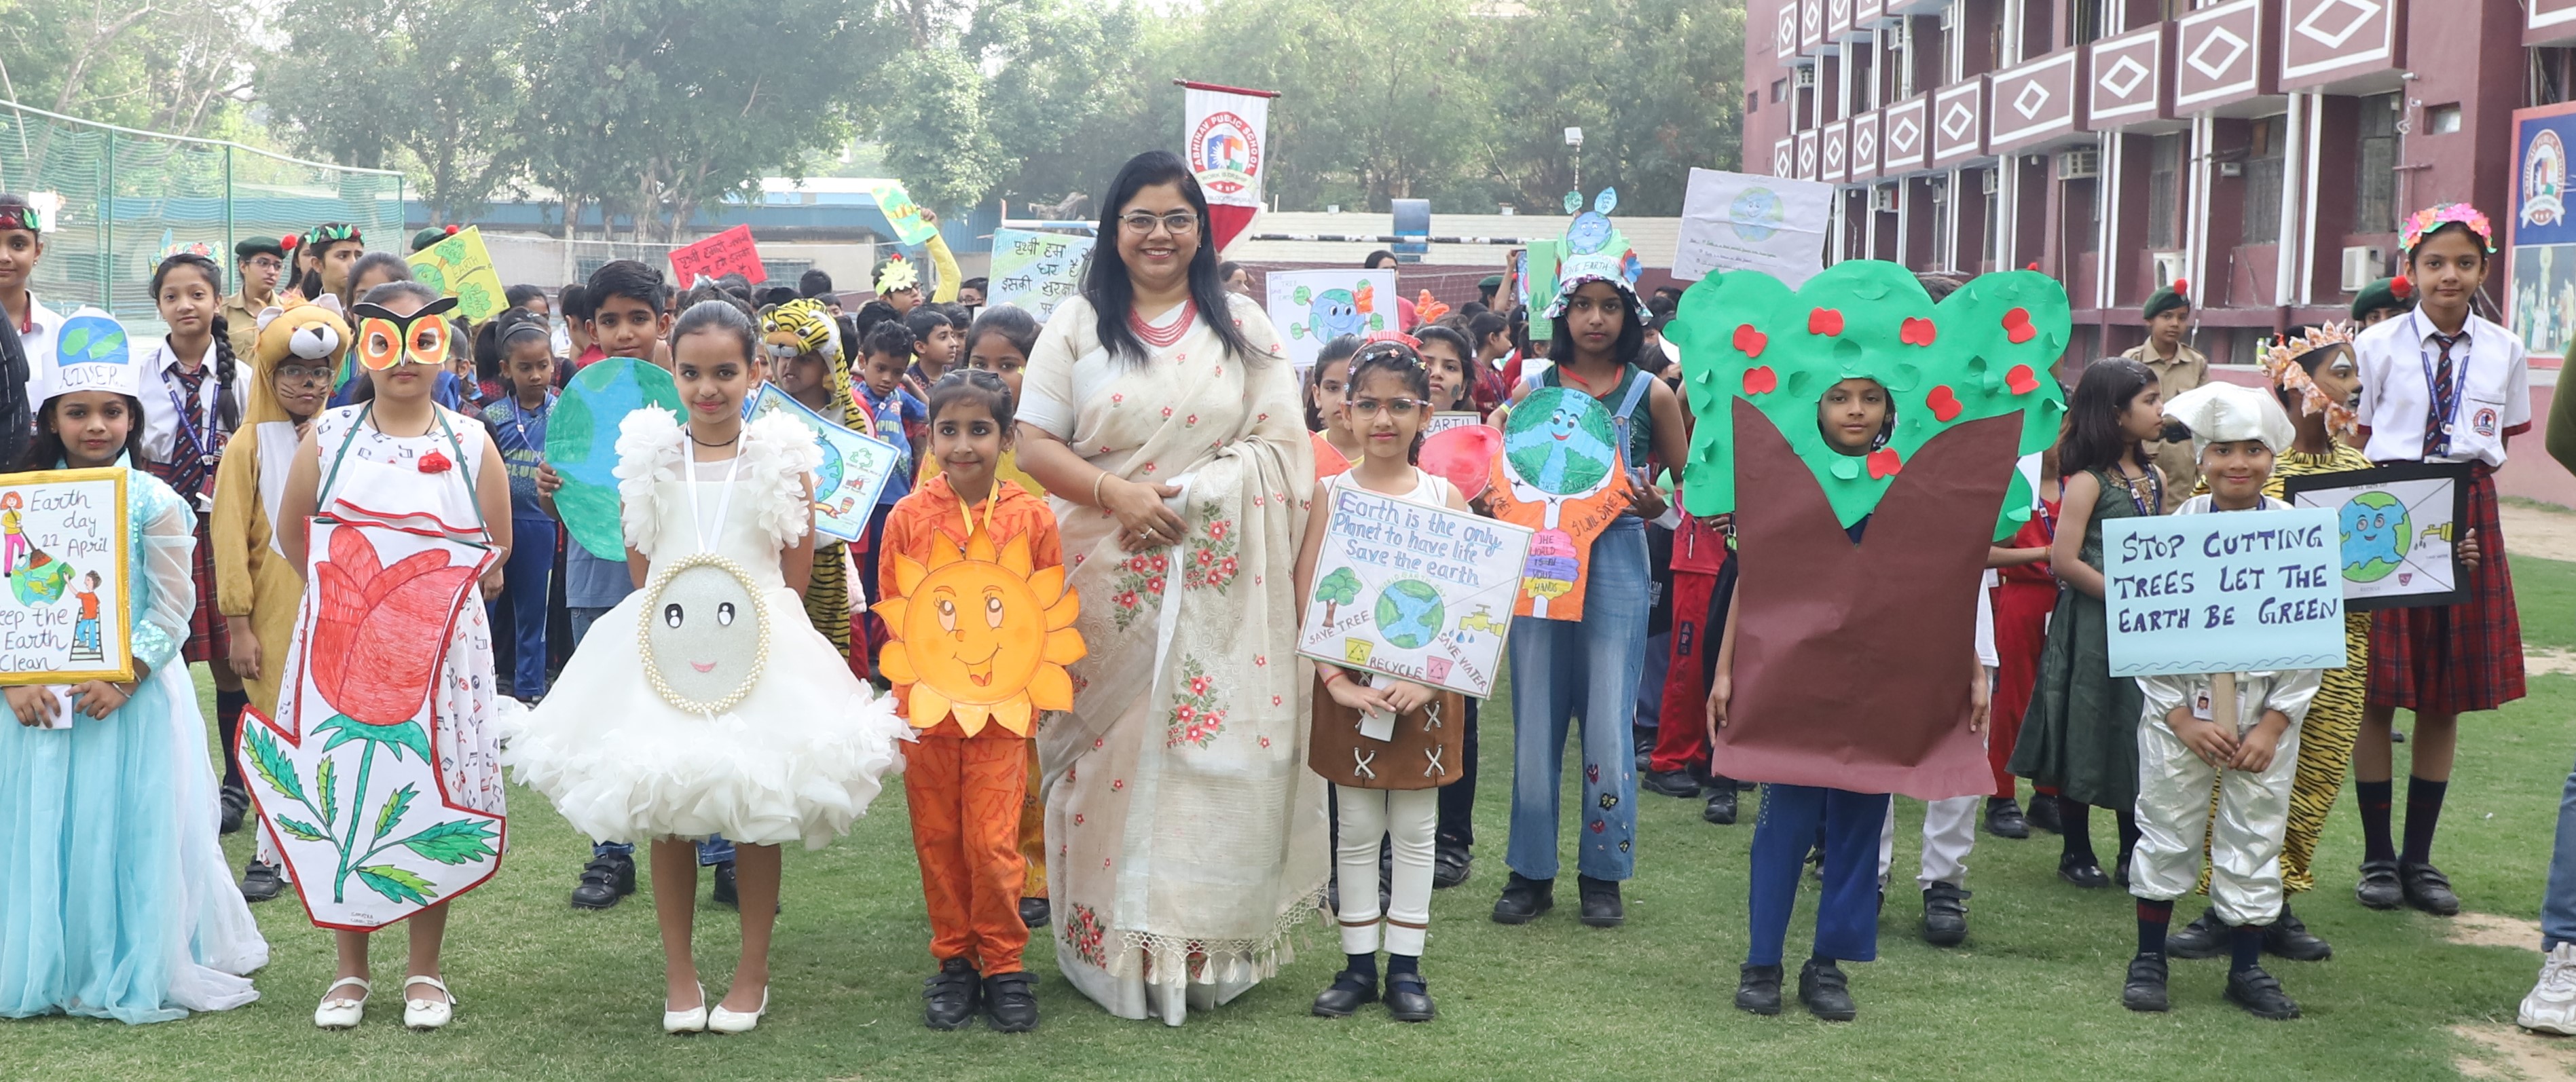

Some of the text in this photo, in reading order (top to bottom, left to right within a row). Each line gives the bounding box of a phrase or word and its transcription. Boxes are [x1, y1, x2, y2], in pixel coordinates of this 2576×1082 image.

[1192, 113, 1258, 170] ABHINAV PUBLIC SCHOOL
[1014, 237, 1039, 255] पृथ्वी
[451, 255, 480, 280] EARTH
[1583, 261, 1609, 272] EARTH
[1001, 274, 1033, 293] इसकी
[30, 488, 92, 512] Earth
[62, 510, 97, 537] day
[1338, 491, 1503, 558] Earth is the only
[41, 534, 60, 548] 22
[67, 537, 109, 559] April
[1331, 512, 1478, 563] Planet to have life
[1539, 535, 1555, 544] THE
[2122, 523, 2324, 565] STOP CUTTING
[1346, 538, 1480, 586] Save the earth
[1533, 582, 1558, 593] HANDS
[2114, 564, 2327, 600] TREES LET THE
[0, 608, 69, 630] eep the
[2118, 596, 2338, 633] EARTH BE GREEN
[1308, 610, 1372, 645] SAVE TREE
[5, 629, 69, 652] Earth
[0, 653, 62, 673] Clean
[1369, 656, 1425, 682] RECYCLE
[1436, 632, 1489, 693] SAVE WATER
